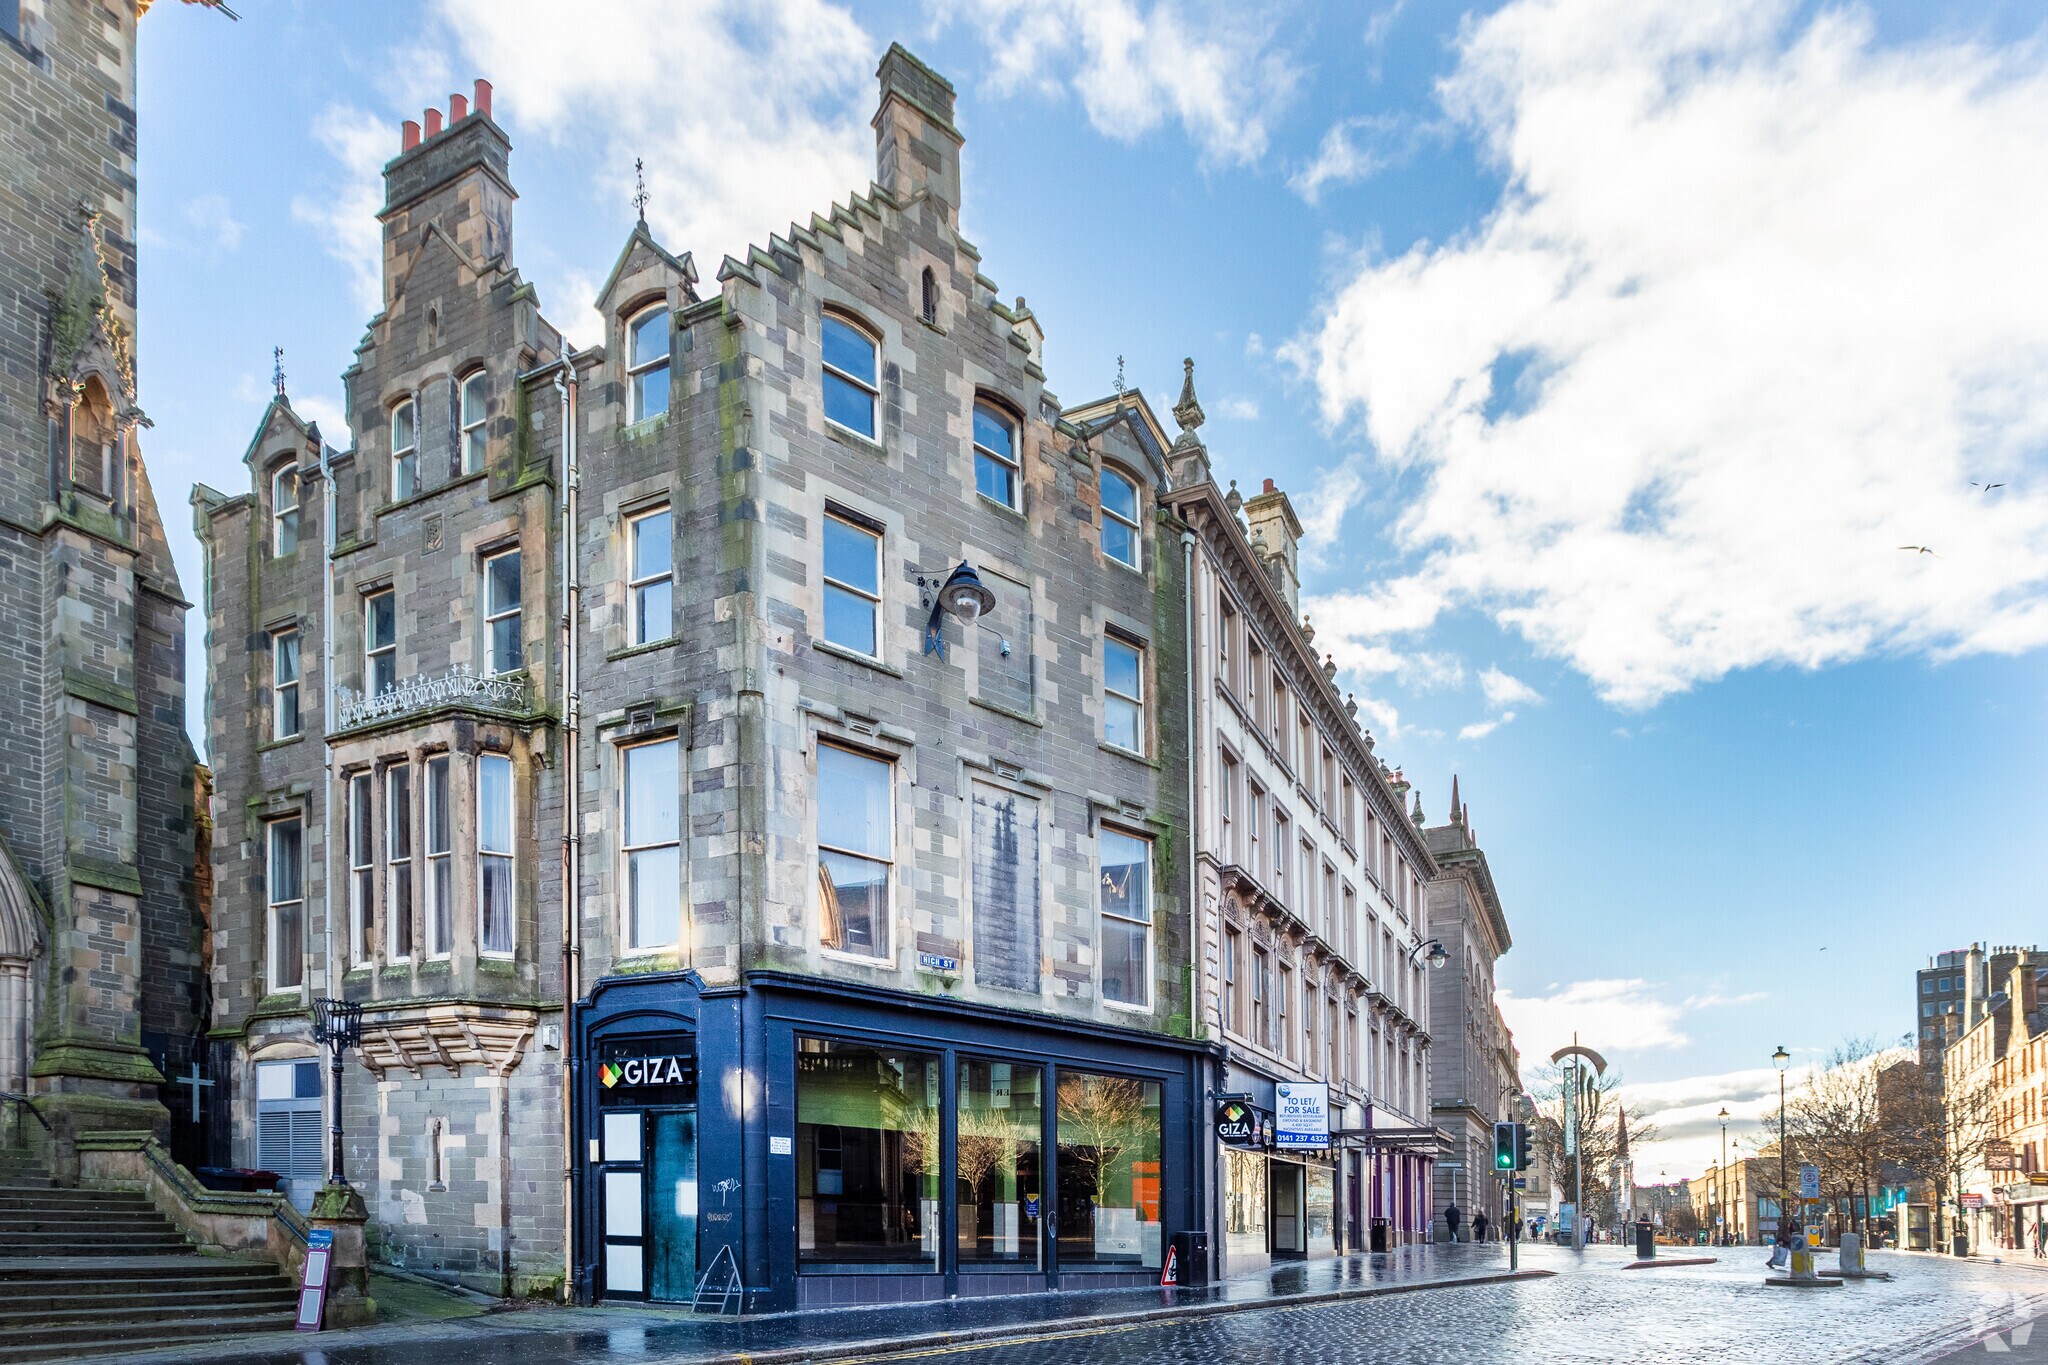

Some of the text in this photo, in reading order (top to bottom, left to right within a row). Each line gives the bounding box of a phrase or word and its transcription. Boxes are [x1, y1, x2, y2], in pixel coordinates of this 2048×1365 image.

[923, 956, 940, 966] HIGH
[624, 1056, 684, 1085] GIZA
[1287, 1097, 1317, 1107] TO LET/
[1284, 1106, 1320, 1114] FOR SALE
[1218, 1122, 1250, 1134] GIZA
[1277, 1134, 1293, 1142] 0141
